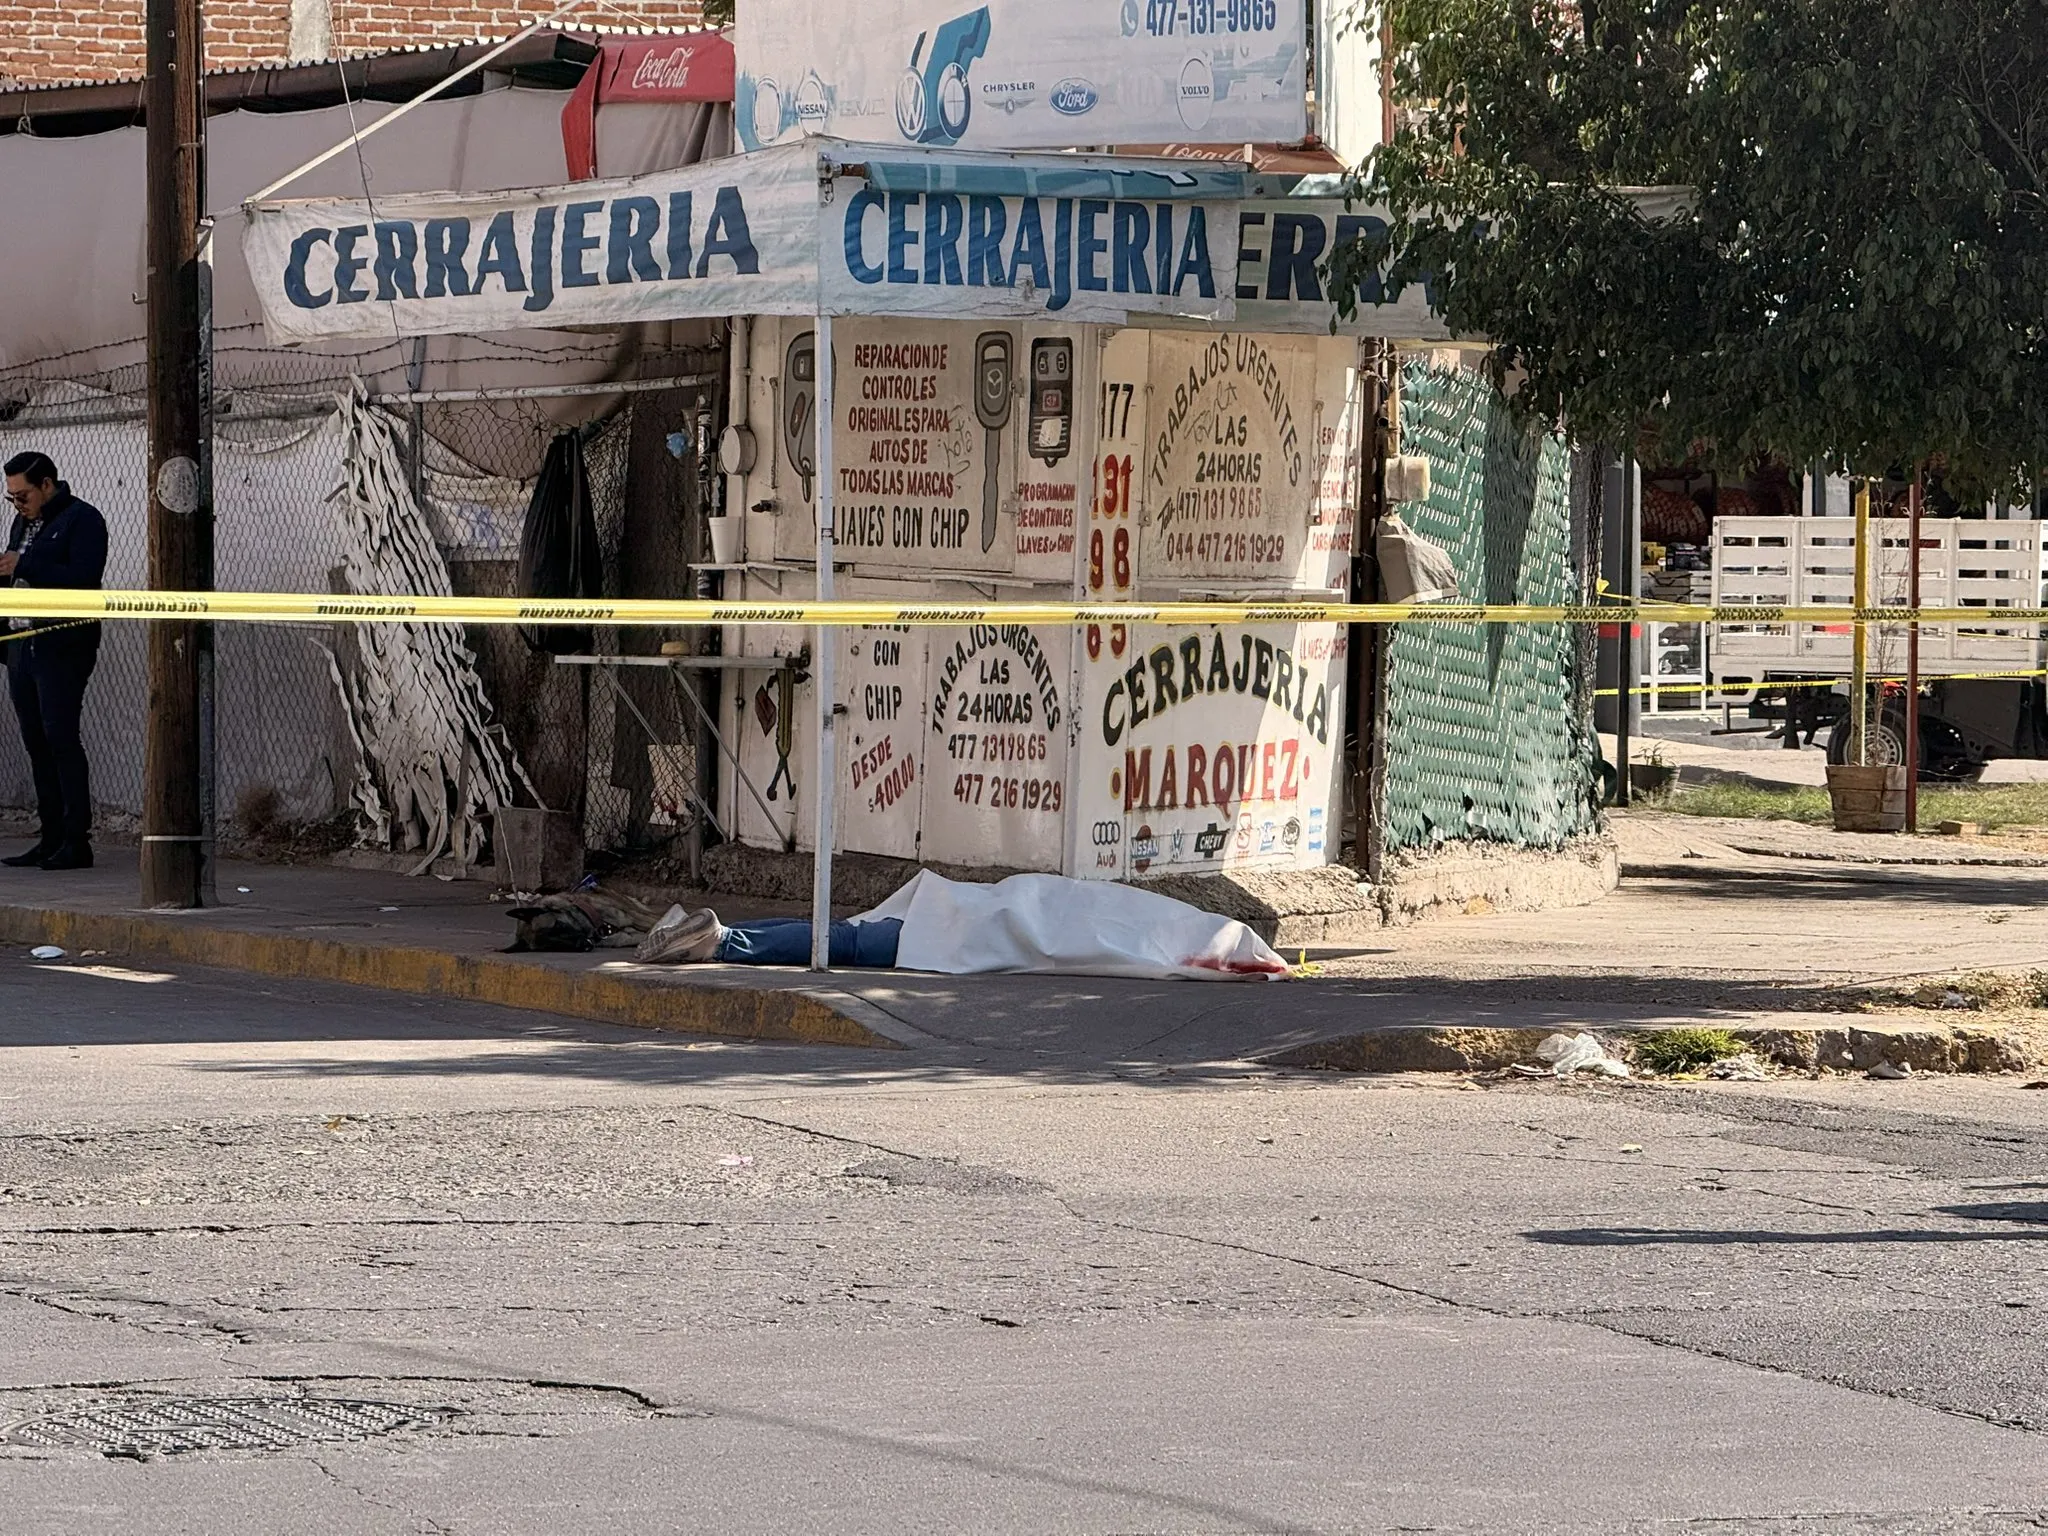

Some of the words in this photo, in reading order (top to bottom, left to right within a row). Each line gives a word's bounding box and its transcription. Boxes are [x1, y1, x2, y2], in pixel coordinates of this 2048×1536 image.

[983, 81, 1035, 93] CHRYSLER
[1058, 82, 1089, 107] Ford
[1181, 86, 1210, 96] VOLVO
[797, 104, 826, 115] NISSAN
[284, 186, 761, 311] CERRAJERIA
[844, 192, 1217, 312] CERRAJERIA
[862, 375, 937, 400] CONTROLES
[1102, 383, 1135, 441] 77
[1151, 332, 1230, 487] TRABAJOS
[1236, 333, 1303, 488] URGENTES
[1215, 413, 1248, 448] LAS
[869, 438, 908, 464] AUTOS
[909, 439, 928, 464] DE
[840, 468, 880, 494] TODAS
[880, 469, 904, 495] LAS
[907, 472, 954, 498] MARCAS
[1028, 507, 1074, 528] CONTROLES
[1176, 486, 1201, 524] (477)
[1203, 488, 1225, 520] 131
[1229, 486, 1262, 520] 9865
[893, 506, 924, 548] CON
[931, 508, 970, 548] CHIP
[1016, 534, 1050, 555] LLAVES
[1167, 531, 1194, 562] 044
[1198, 532, 1221, 562] 477
[1224, 532, 1247, 563] 216
[873, 640, 901, 667] CON
[932, 624, 999, 734] TRABAJOS
[1001, 624, 1061, 732] URGENTES
[980, 658, 1010, 685] LAS
[865, 685, 903, 721] CHIP
[1102, 631, 1329, 747] CERRAJERIA
[948, 734, 977, 760] 477
[851, 735, 893, 790] DESDE
[953, 773, 984, 804] 477
[990, 776, 1018, 809] 216
[1021, 780, 1062, 812] 1929
[1124, 738, 1300, 821] MARQUEZ
[1130, 838, 1160, 858] NISSAN
[1199, 834, 1221, 851] CHEVY
[1096, 850, 1117, 868] Audi
